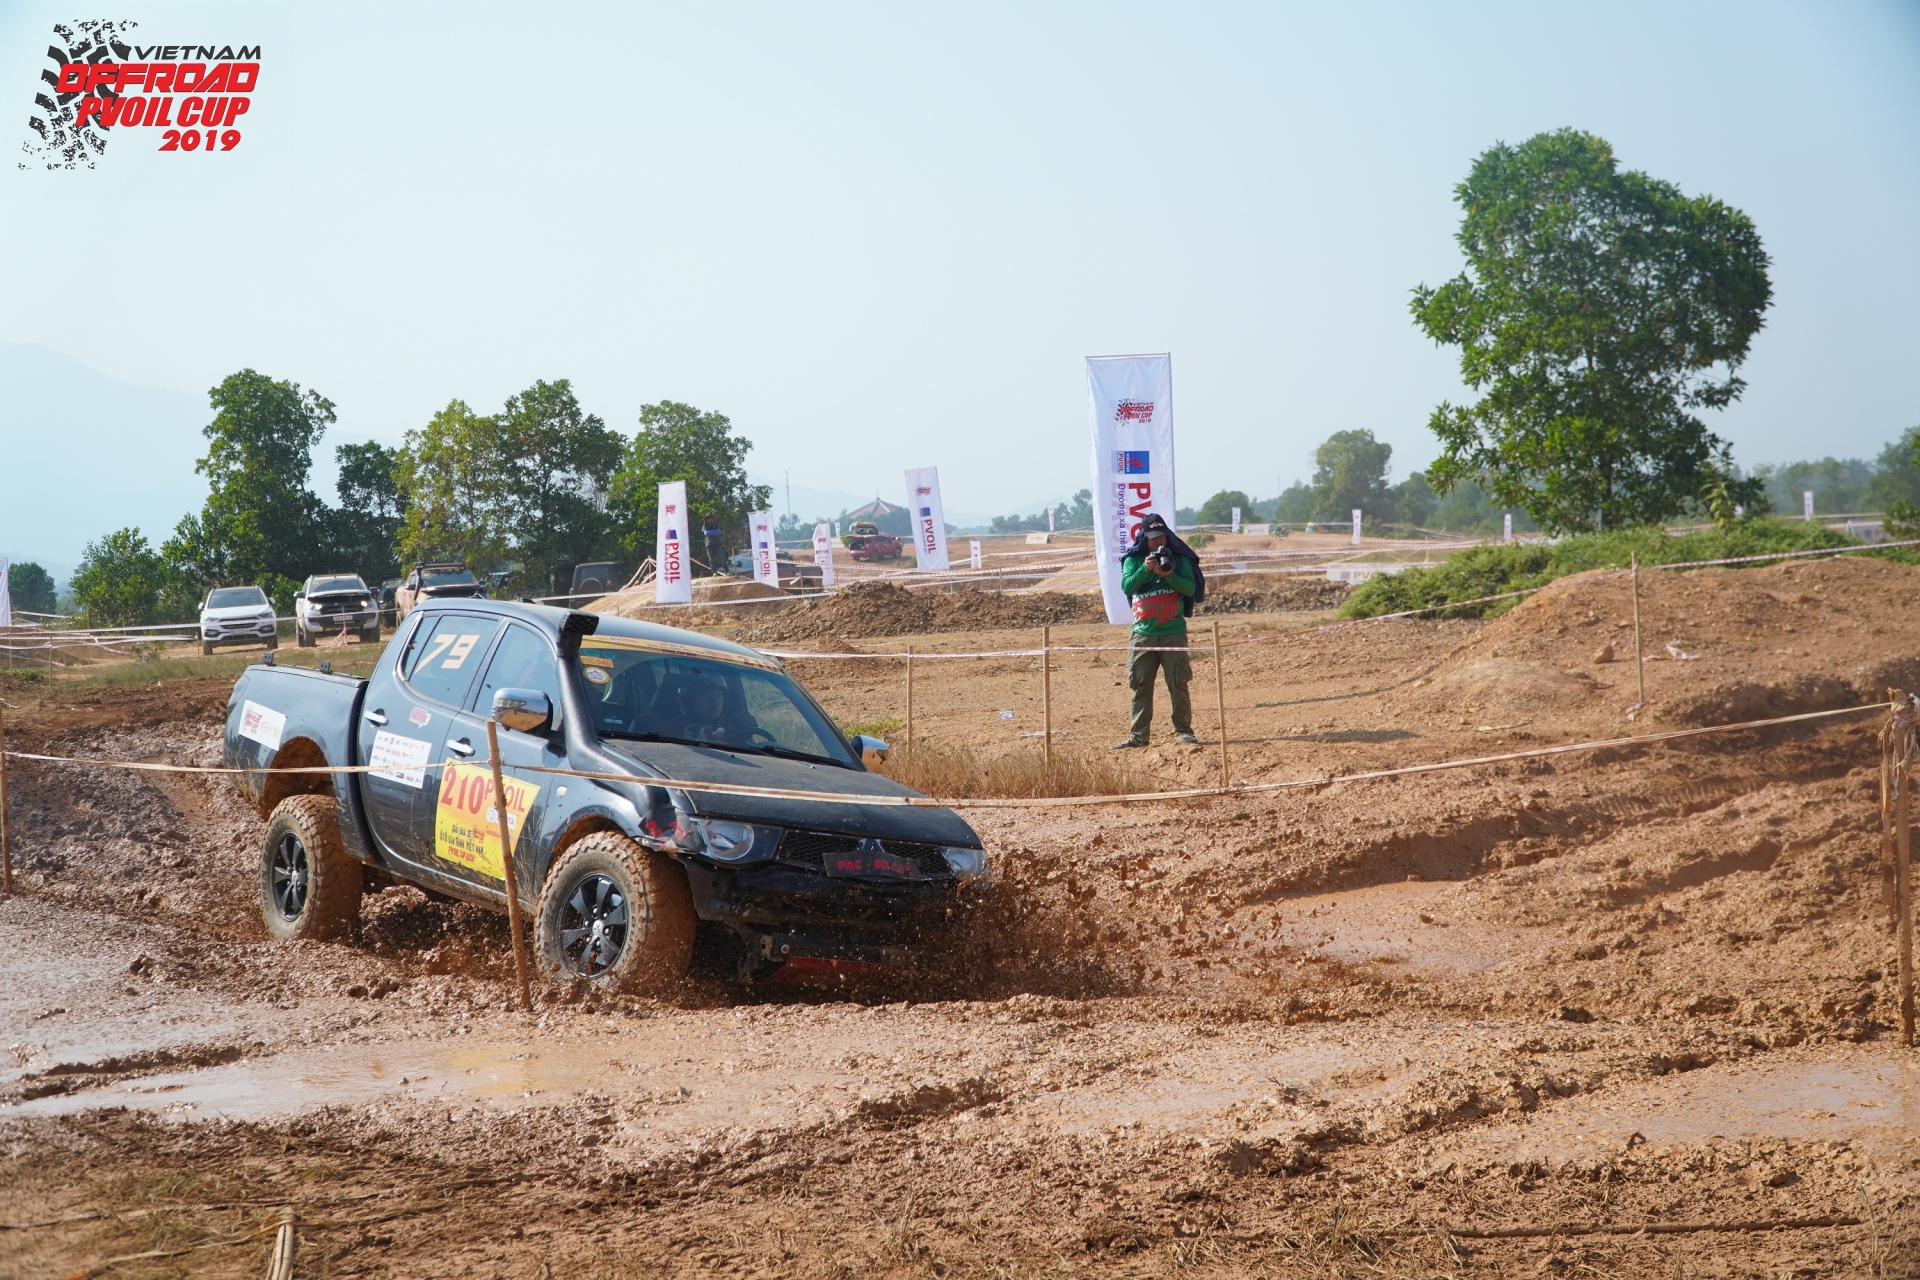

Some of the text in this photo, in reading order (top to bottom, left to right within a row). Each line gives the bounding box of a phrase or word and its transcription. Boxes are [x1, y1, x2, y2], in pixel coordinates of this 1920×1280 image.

[1117, 483, 1126, 517] Đường
[923, 518, 937, 555] PVOIL
[1119, 518, 1126, 529] xa
[1119, 531, 1128, 554] thêm
[668, 542, 681, 584] PVOIL
[1143, 589, 1175, 598] VIETNA
[414, 634, 481, 675] 79
[440, 766, 485, 815] 210
[837, 859, 863, 871] PAC
